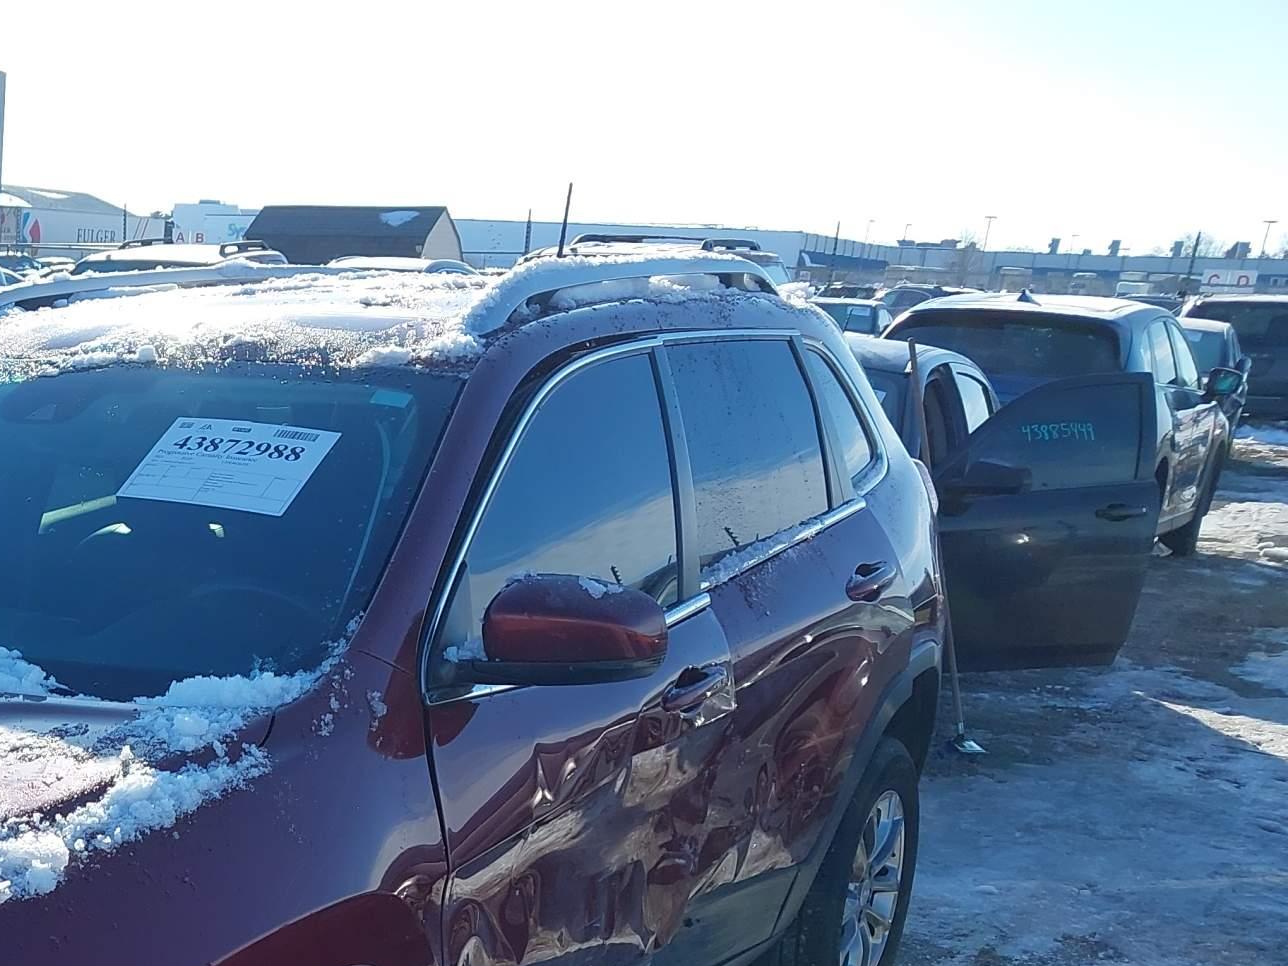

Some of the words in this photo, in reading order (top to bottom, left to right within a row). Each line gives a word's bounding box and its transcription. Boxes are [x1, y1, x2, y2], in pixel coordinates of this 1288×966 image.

[77, 228, 116, 243] FULGER
[176, 232, 185, 242] A
[196, 232, 204, 242] B
[173, 435, 306, 462] 43872988
